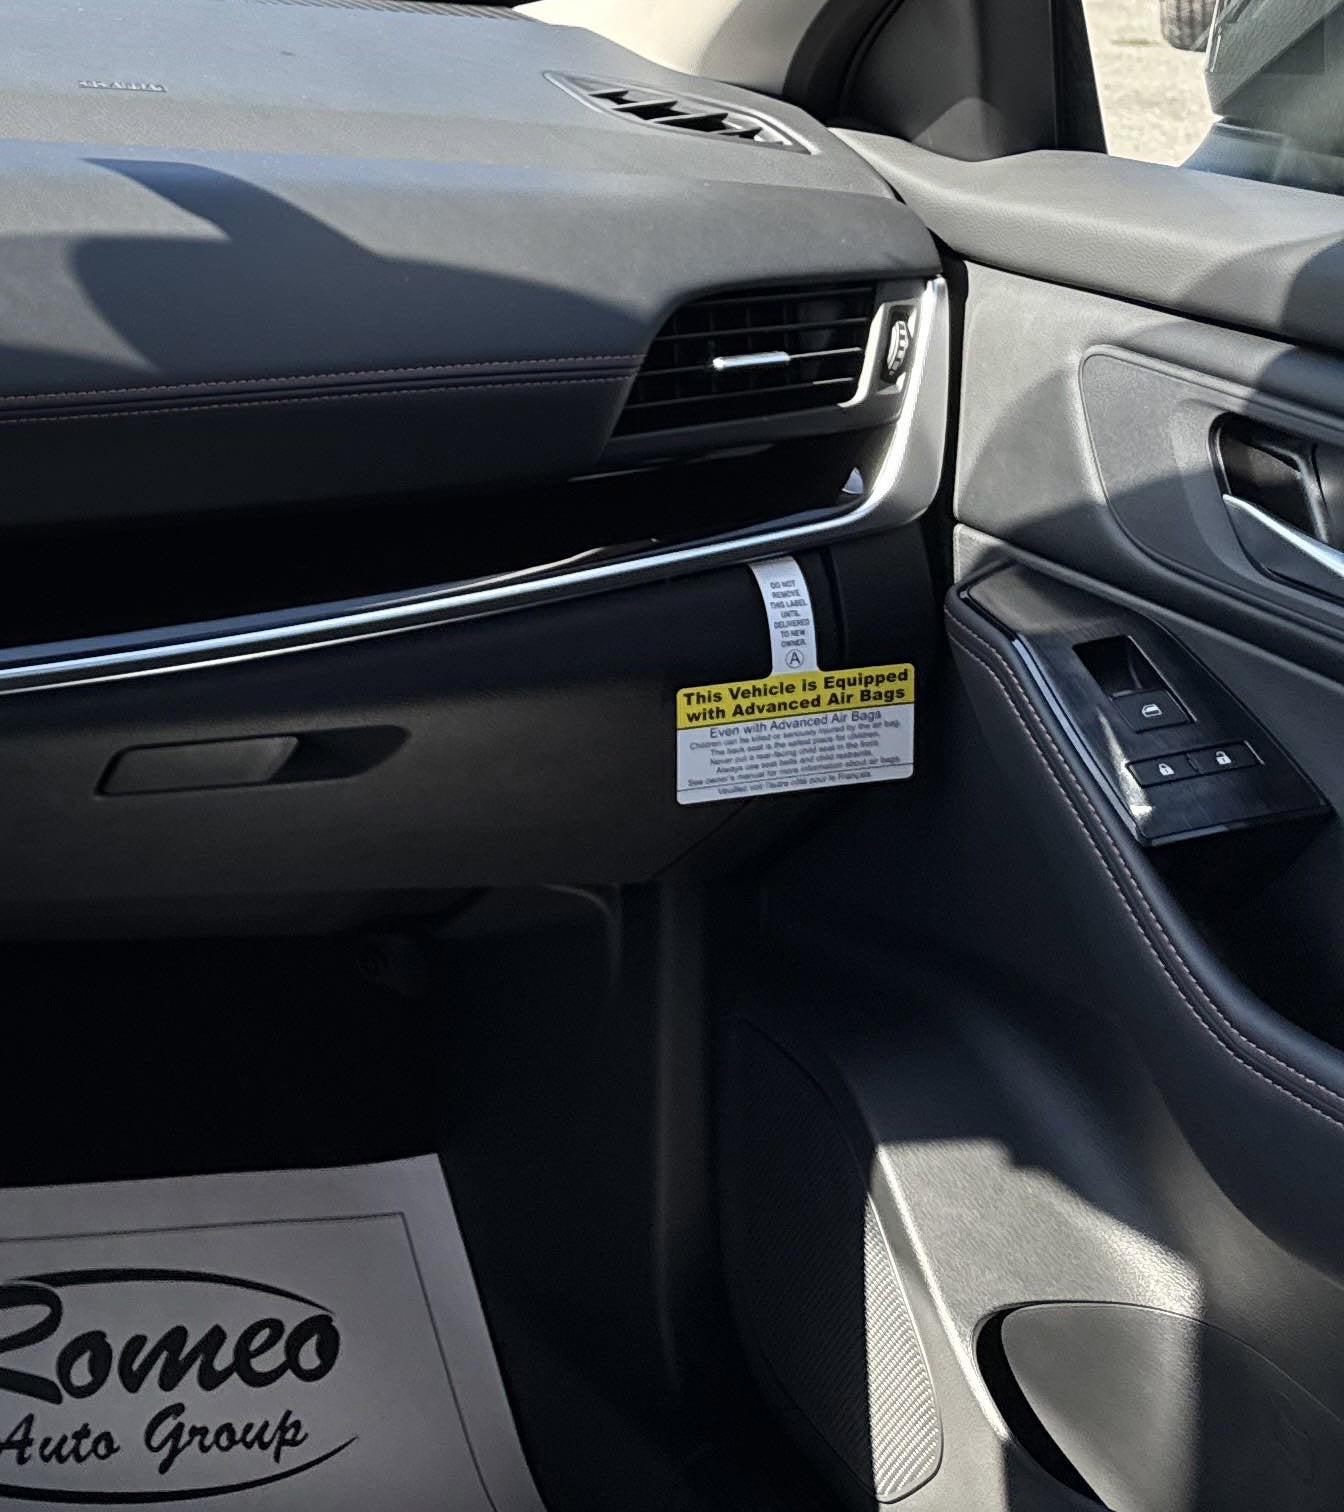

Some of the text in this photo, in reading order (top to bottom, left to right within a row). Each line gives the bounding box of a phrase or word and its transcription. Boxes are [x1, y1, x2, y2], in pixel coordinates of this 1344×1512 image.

[781, 580, 796, 588] NOT
[772, 589, 801, 598] REMOVE
[785, 599, 808, 608] LABEL
[780, 610, 801, 618] UNTIL
[773, 619, 810, 629] DELIVERED
[780, 629, 806, 638] TO NEW
[683, 690, 723, 707] This
[728, 681, 796, 701] Vehicle
[823, 668, 909, 690] Equipped
[686, 686, 906, 724] with Advanced Air Bags
[709, 725, 740, 739] Even
[743, 723, 768, 734] with
[769, 714, 829, 731] Advanced
[831, 712, 849, 724] Air
[852, 710, 883, 724] Bags
[143, 1401, 310, 1475] Group
